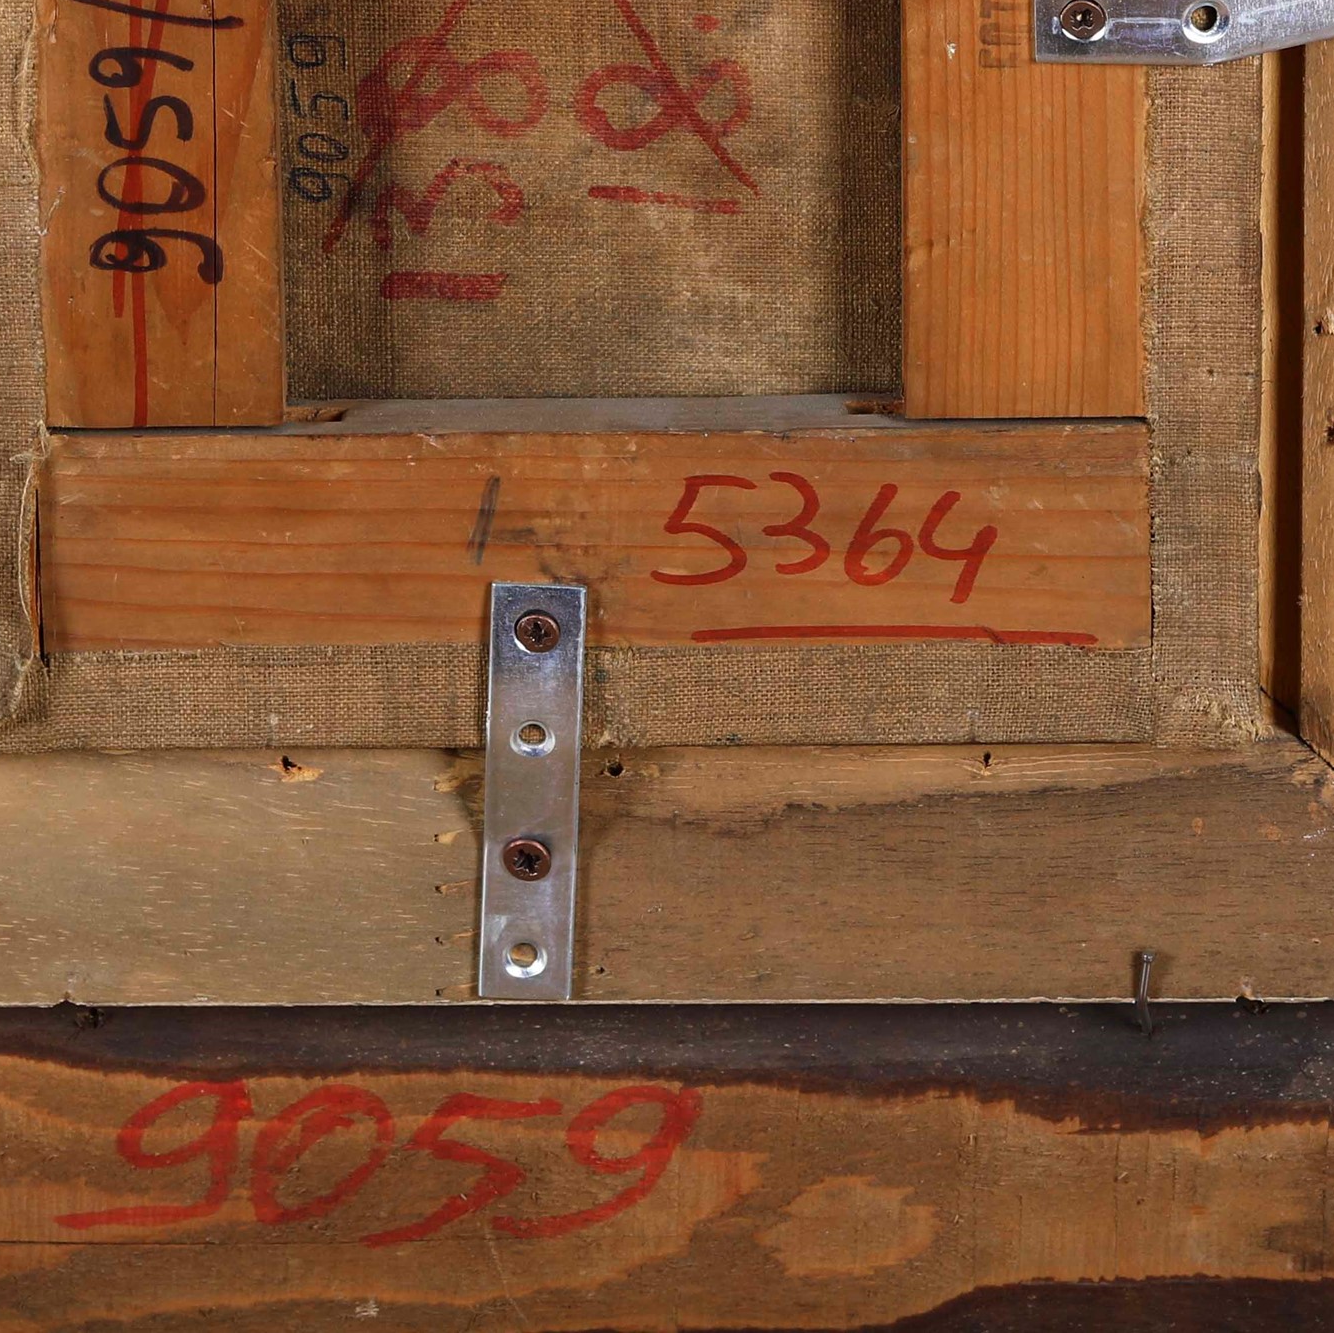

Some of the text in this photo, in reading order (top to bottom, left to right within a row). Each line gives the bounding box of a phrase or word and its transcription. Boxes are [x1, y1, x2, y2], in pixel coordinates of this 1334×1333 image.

[286, 32, 351, 204] 9059
[354, 46, 553, 303] 138
[650, 470, 999, 603] 5364
[55, 1076, 703, 1248] 9059
